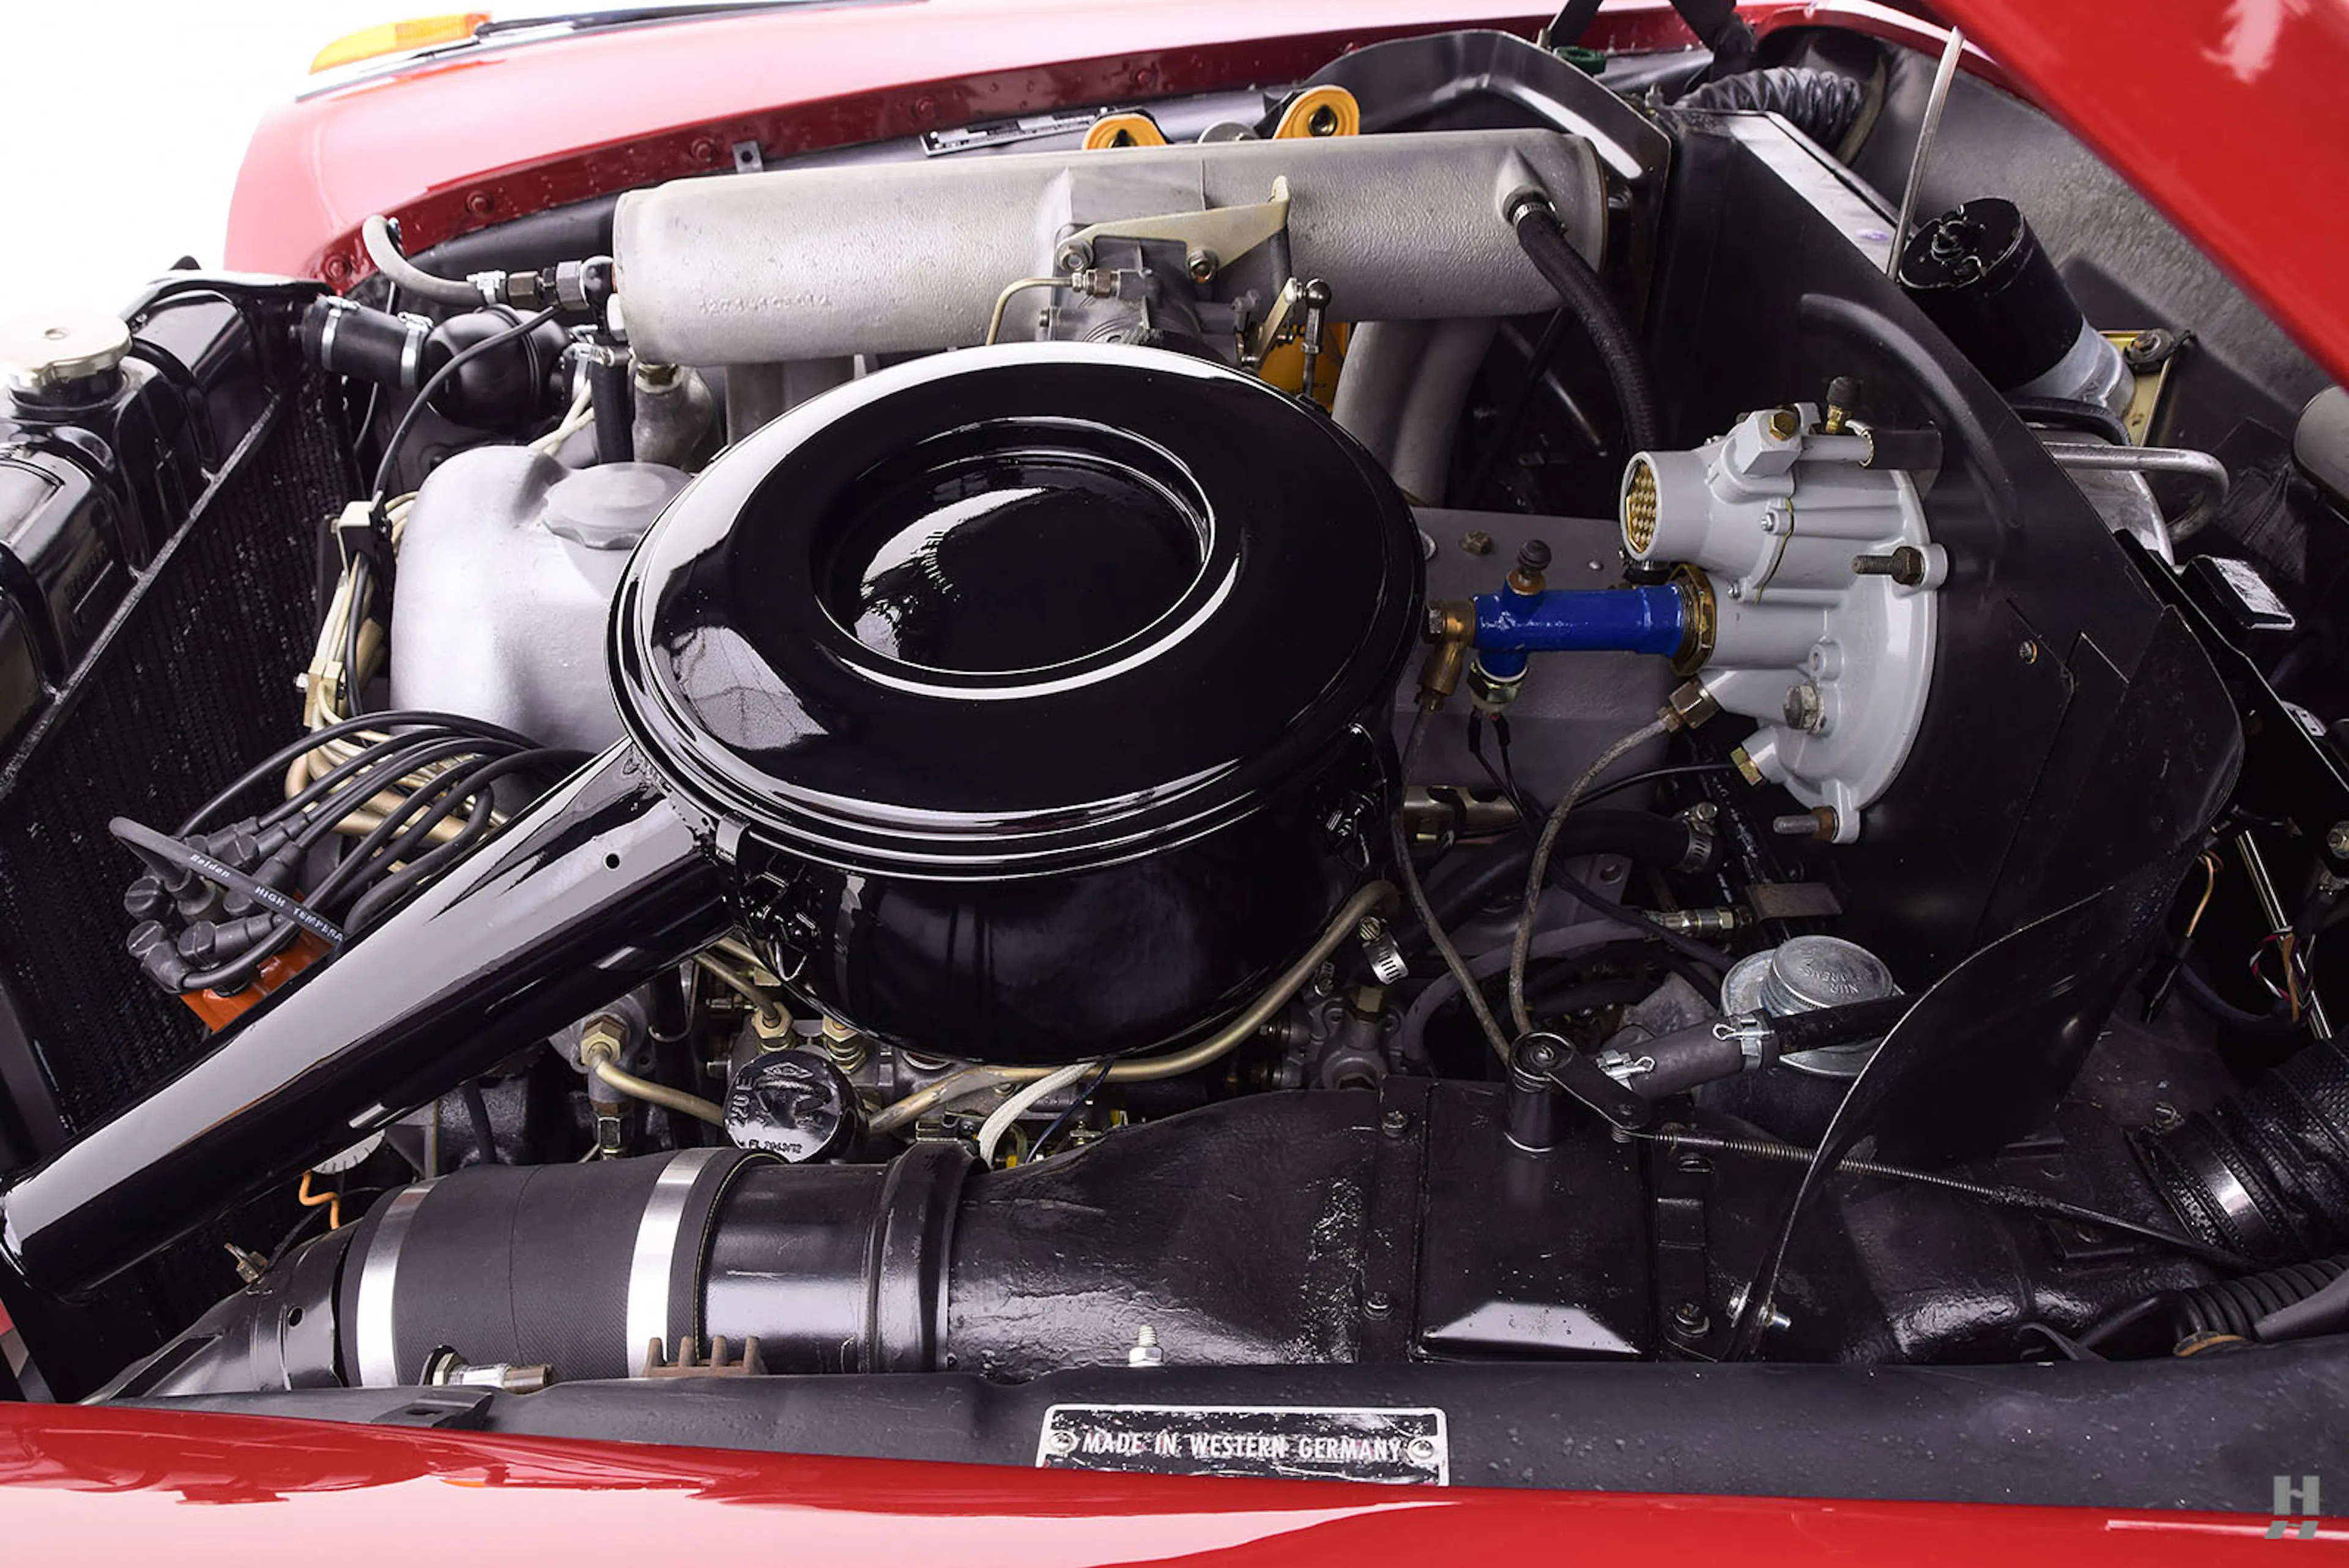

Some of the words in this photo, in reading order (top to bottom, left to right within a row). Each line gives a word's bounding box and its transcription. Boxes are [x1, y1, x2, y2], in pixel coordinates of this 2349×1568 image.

[254, 885, 285, 907] HIGH
[1082, 1431, 1142, 1454] MADE
[1154, 1432, 1179, 1455] IN
[1190, 1433, 1286, 1457] WESTERN
[1298, 1438, 1400, 1462] GERMANY
